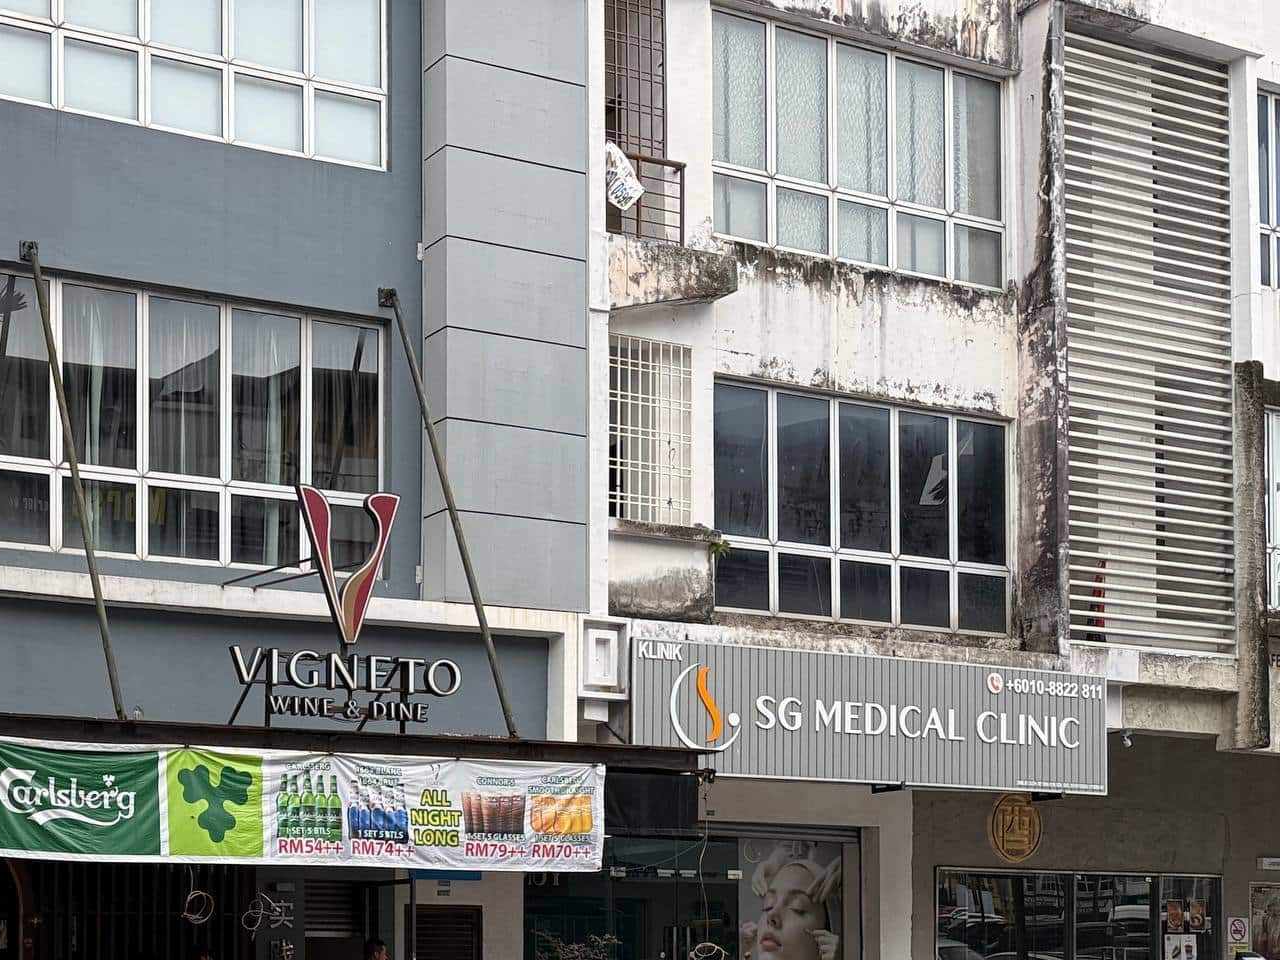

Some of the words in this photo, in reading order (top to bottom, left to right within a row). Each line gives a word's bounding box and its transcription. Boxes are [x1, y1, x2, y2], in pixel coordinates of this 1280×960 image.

[638, 641, 683, 661] KLINIK
[229, 645, 462, 697] VIGNETO
[1006, 678, 1078, 698] +6010-8822
[1081, 684, 1102, 700] 811
[270, 695, 335, 717] WINE
[345, 700, 361, 718] &
[373, 701, 429, 722] DINE
[755, 695, 802, 732] SG
[814, 699, 965, 742] MEDICAL
[975, 711, 1081, 749] CLINIC
[420, 788, 451, 807] ALL
[410, 808, 462, 828] NIGHT
[363, 830, 377, 838] SET
[378, 830, 384, 838] 5
[385, 831, 404, 839] BTLS
[413, 829, 459, 847] LONG
[492, 833, 526, 842] GLASSES
[278, 839, 343, 854] RM54++
[352, 841, 415, 857] RM74++
[465, 843, 527, 858] RM79++
[531, 843, 592, 859] RM70++
